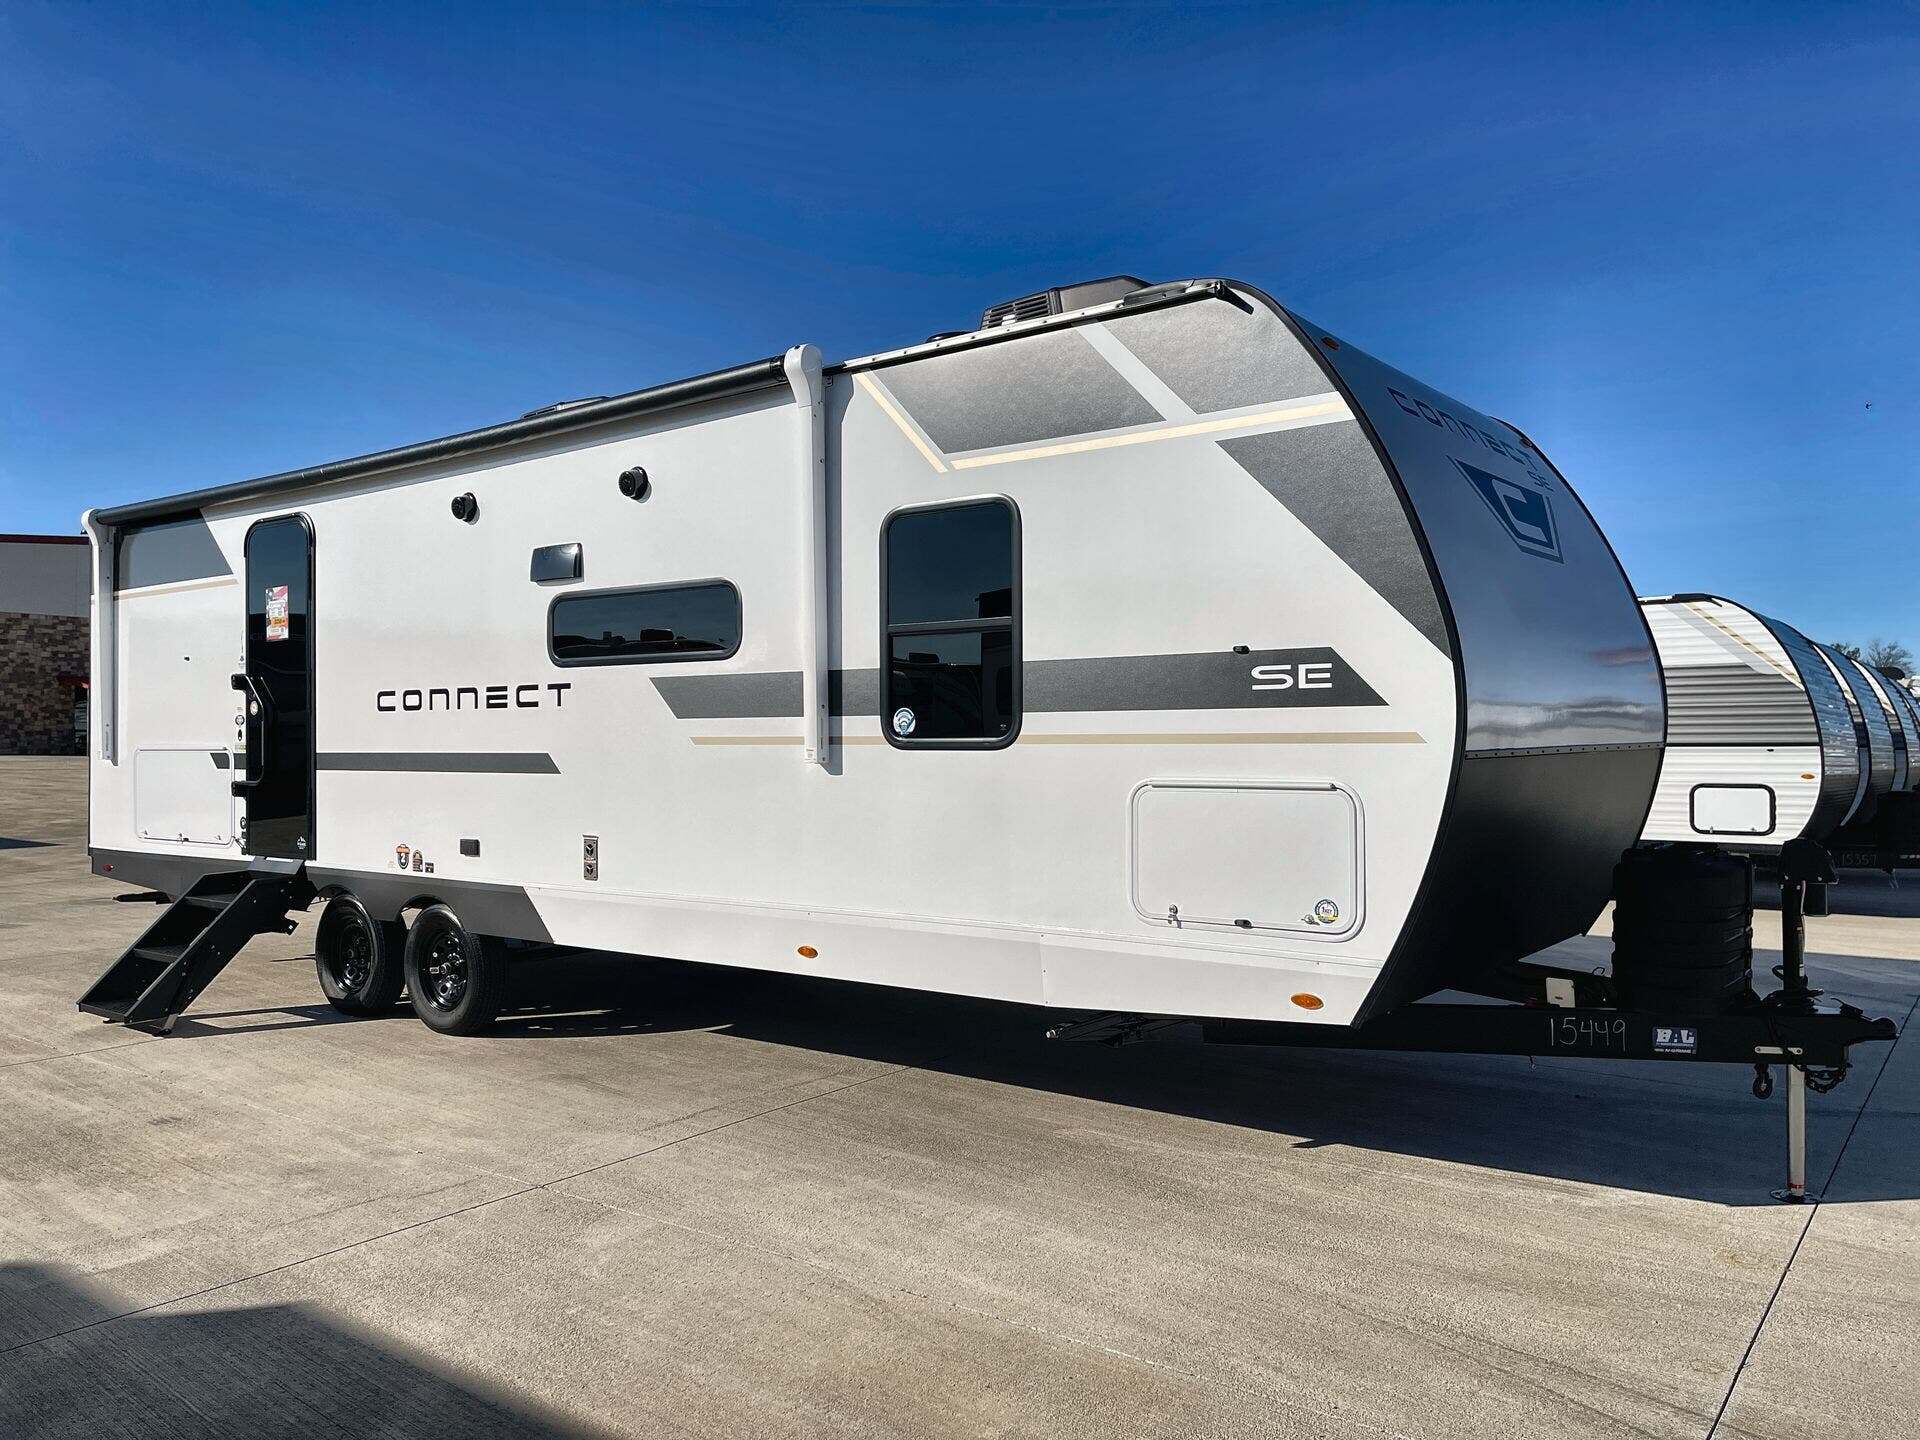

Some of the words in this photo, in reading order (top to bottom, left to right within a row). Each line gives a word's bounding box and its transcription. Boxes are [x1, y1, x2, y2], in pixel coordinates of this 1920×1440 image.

[1386, 386, 1538, 472] CONNECT
[1251, 663, 1333, 691] SE
[377, 682, 572, 712] CONNECT
[1550, 1017, 1626, 1052] 15449
